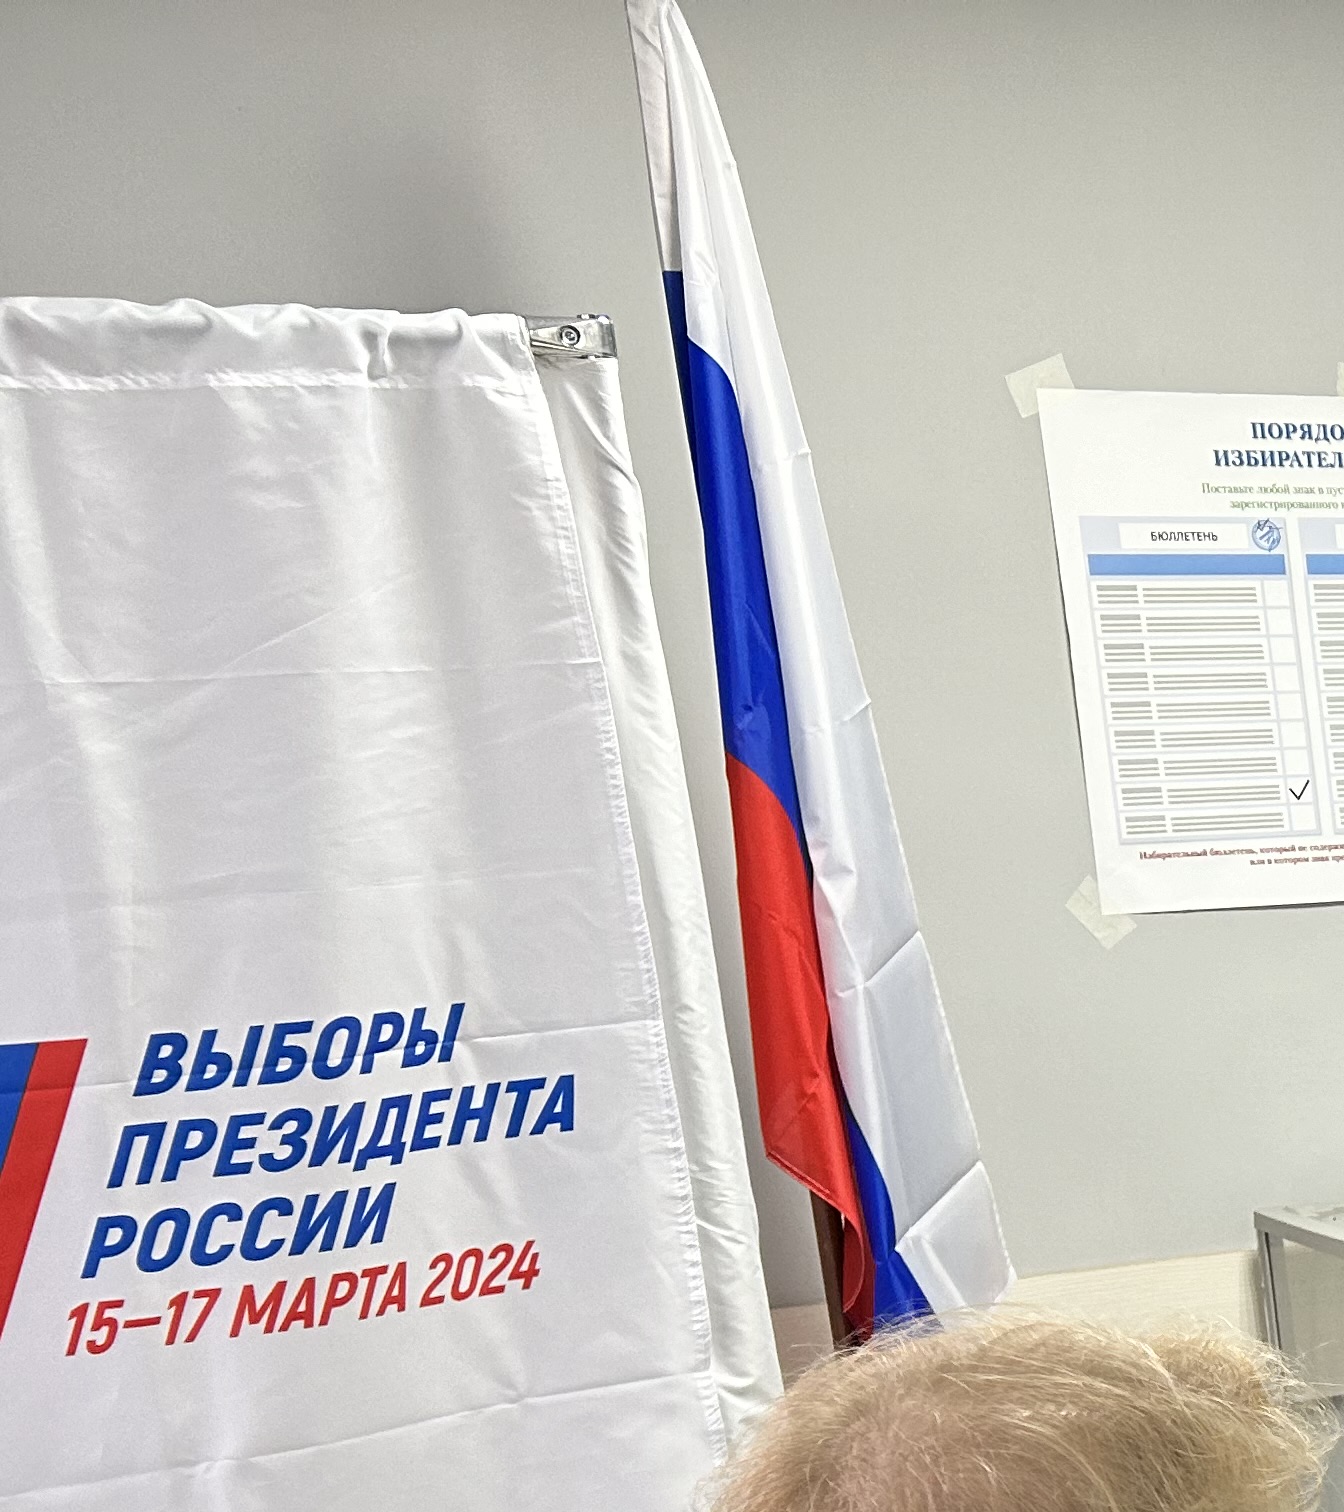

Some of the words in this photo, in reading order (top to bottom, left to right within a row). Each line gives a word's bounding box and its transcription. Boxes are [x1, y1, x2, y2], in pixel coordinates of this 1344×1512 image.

[1151, 531, 1218, 542] БЮЛЛЕТЕНЬ
[133, 1003, 465, 1096] ВЫБОРЫ
[107, 1075, 576, 1188] ПРЕЗИДЕНТА
[81, 1183, 396, 1278] РОССИИ
[229, 1262, 406, 1338] МАРТА
[420, 1240, 541, 1307] 2024
